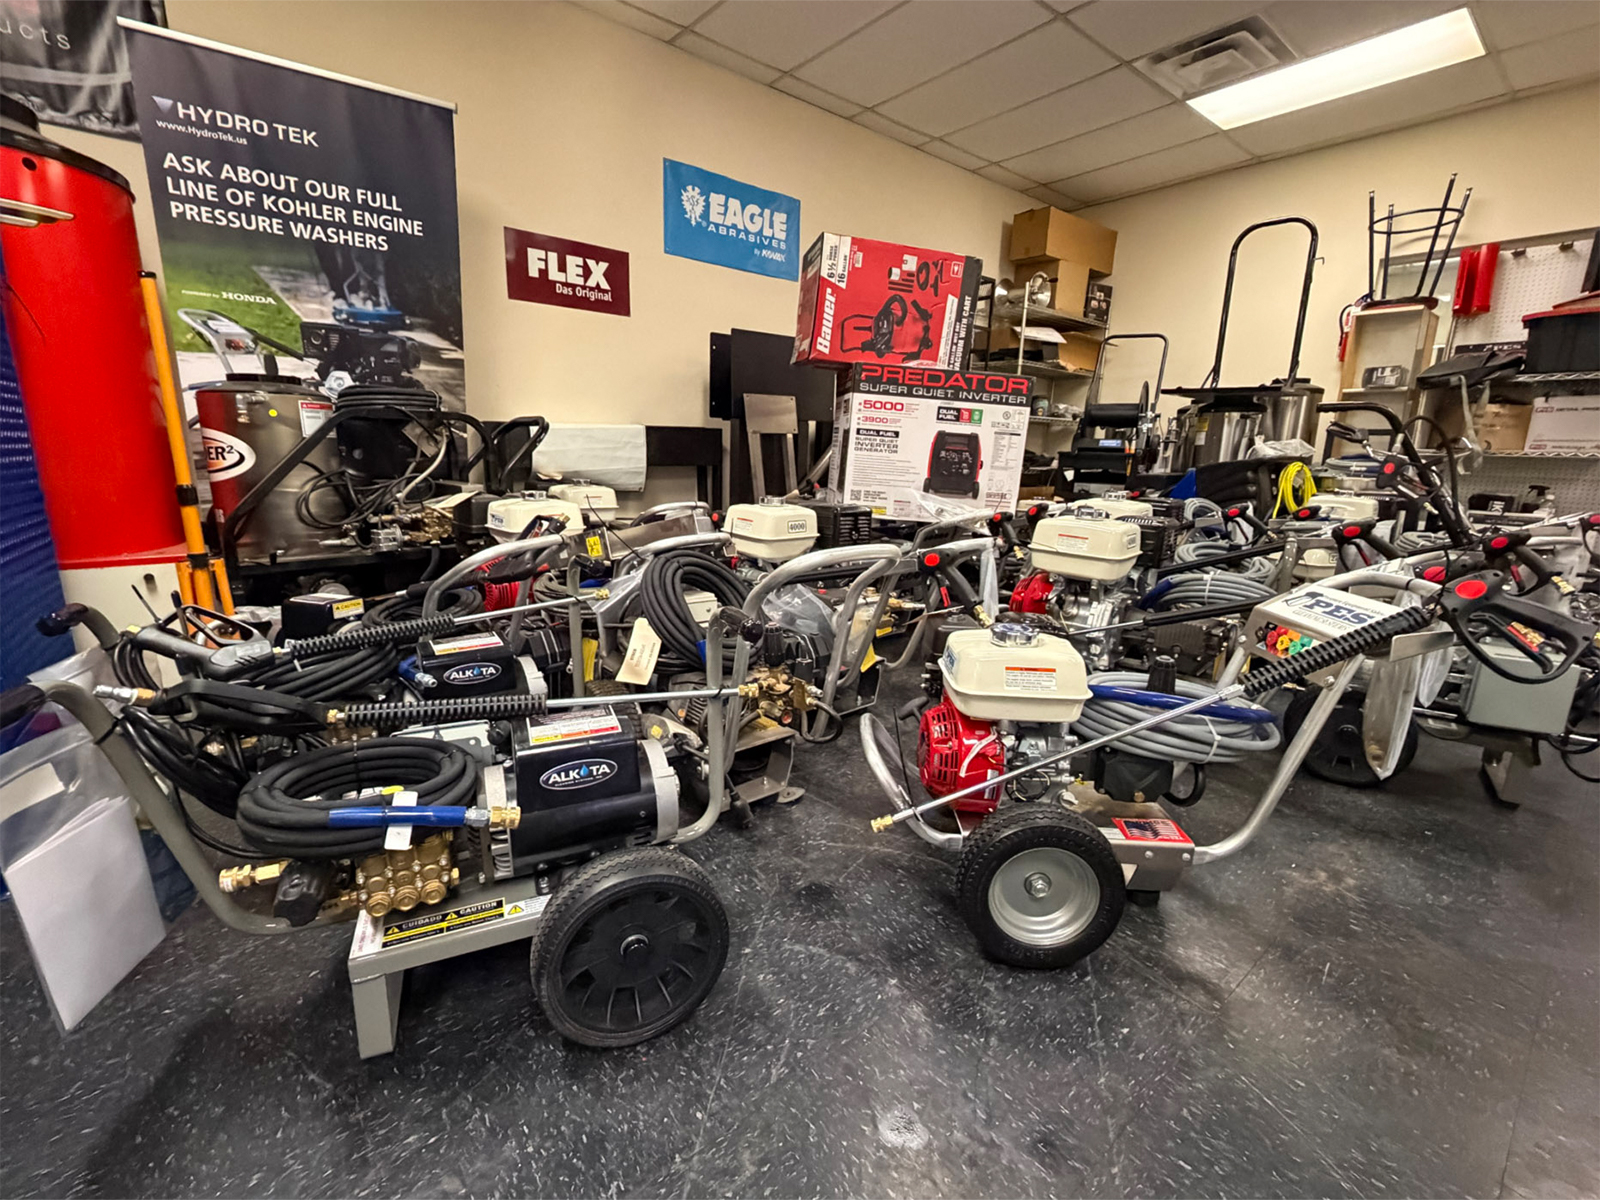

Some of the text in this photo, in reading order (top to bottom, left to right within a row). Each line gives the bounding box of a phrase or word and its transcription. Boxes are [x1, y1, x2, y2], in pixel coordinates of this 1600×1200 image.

[156, 119, 248, 145] www.HydroTek.us
[177, 101, 319, 148] HYDRO TEK
[163, 152, 402, 212] ASK ABOUT OUR FULL
[166, 176, 423, 237] LINE OF KOHLER ENGINE
[709, 192, 787, 240] EAGLE
[170, 200, 389, 251] PRESSURE WASHERS
[707, 223, 786, 250] ABRASIVES
[527, 247, 611, 290] FLEX
[837, 273, 846, 283] 16
[221, 291, 277, 305] HONDA
[555, 283, 612, 302] Das Original
[816, 287, 836, 355] Bauer
[954, 295, 972, 371] VACUUM WITH CART
[861, 365, 1029, 394] PREDATOR
[859, 382, 1027, 405] SUPER QUIET INVERTER
[863, 400, 904, 412] 5000
[861, 415, 889, 424] 3900
[854, 441, 898, 449] INVERTER
[1302, 599, 1375, 625] PES
[402, 914, 442, 929] CUIDADO
[459, 901, 498, 915] CAUTION
